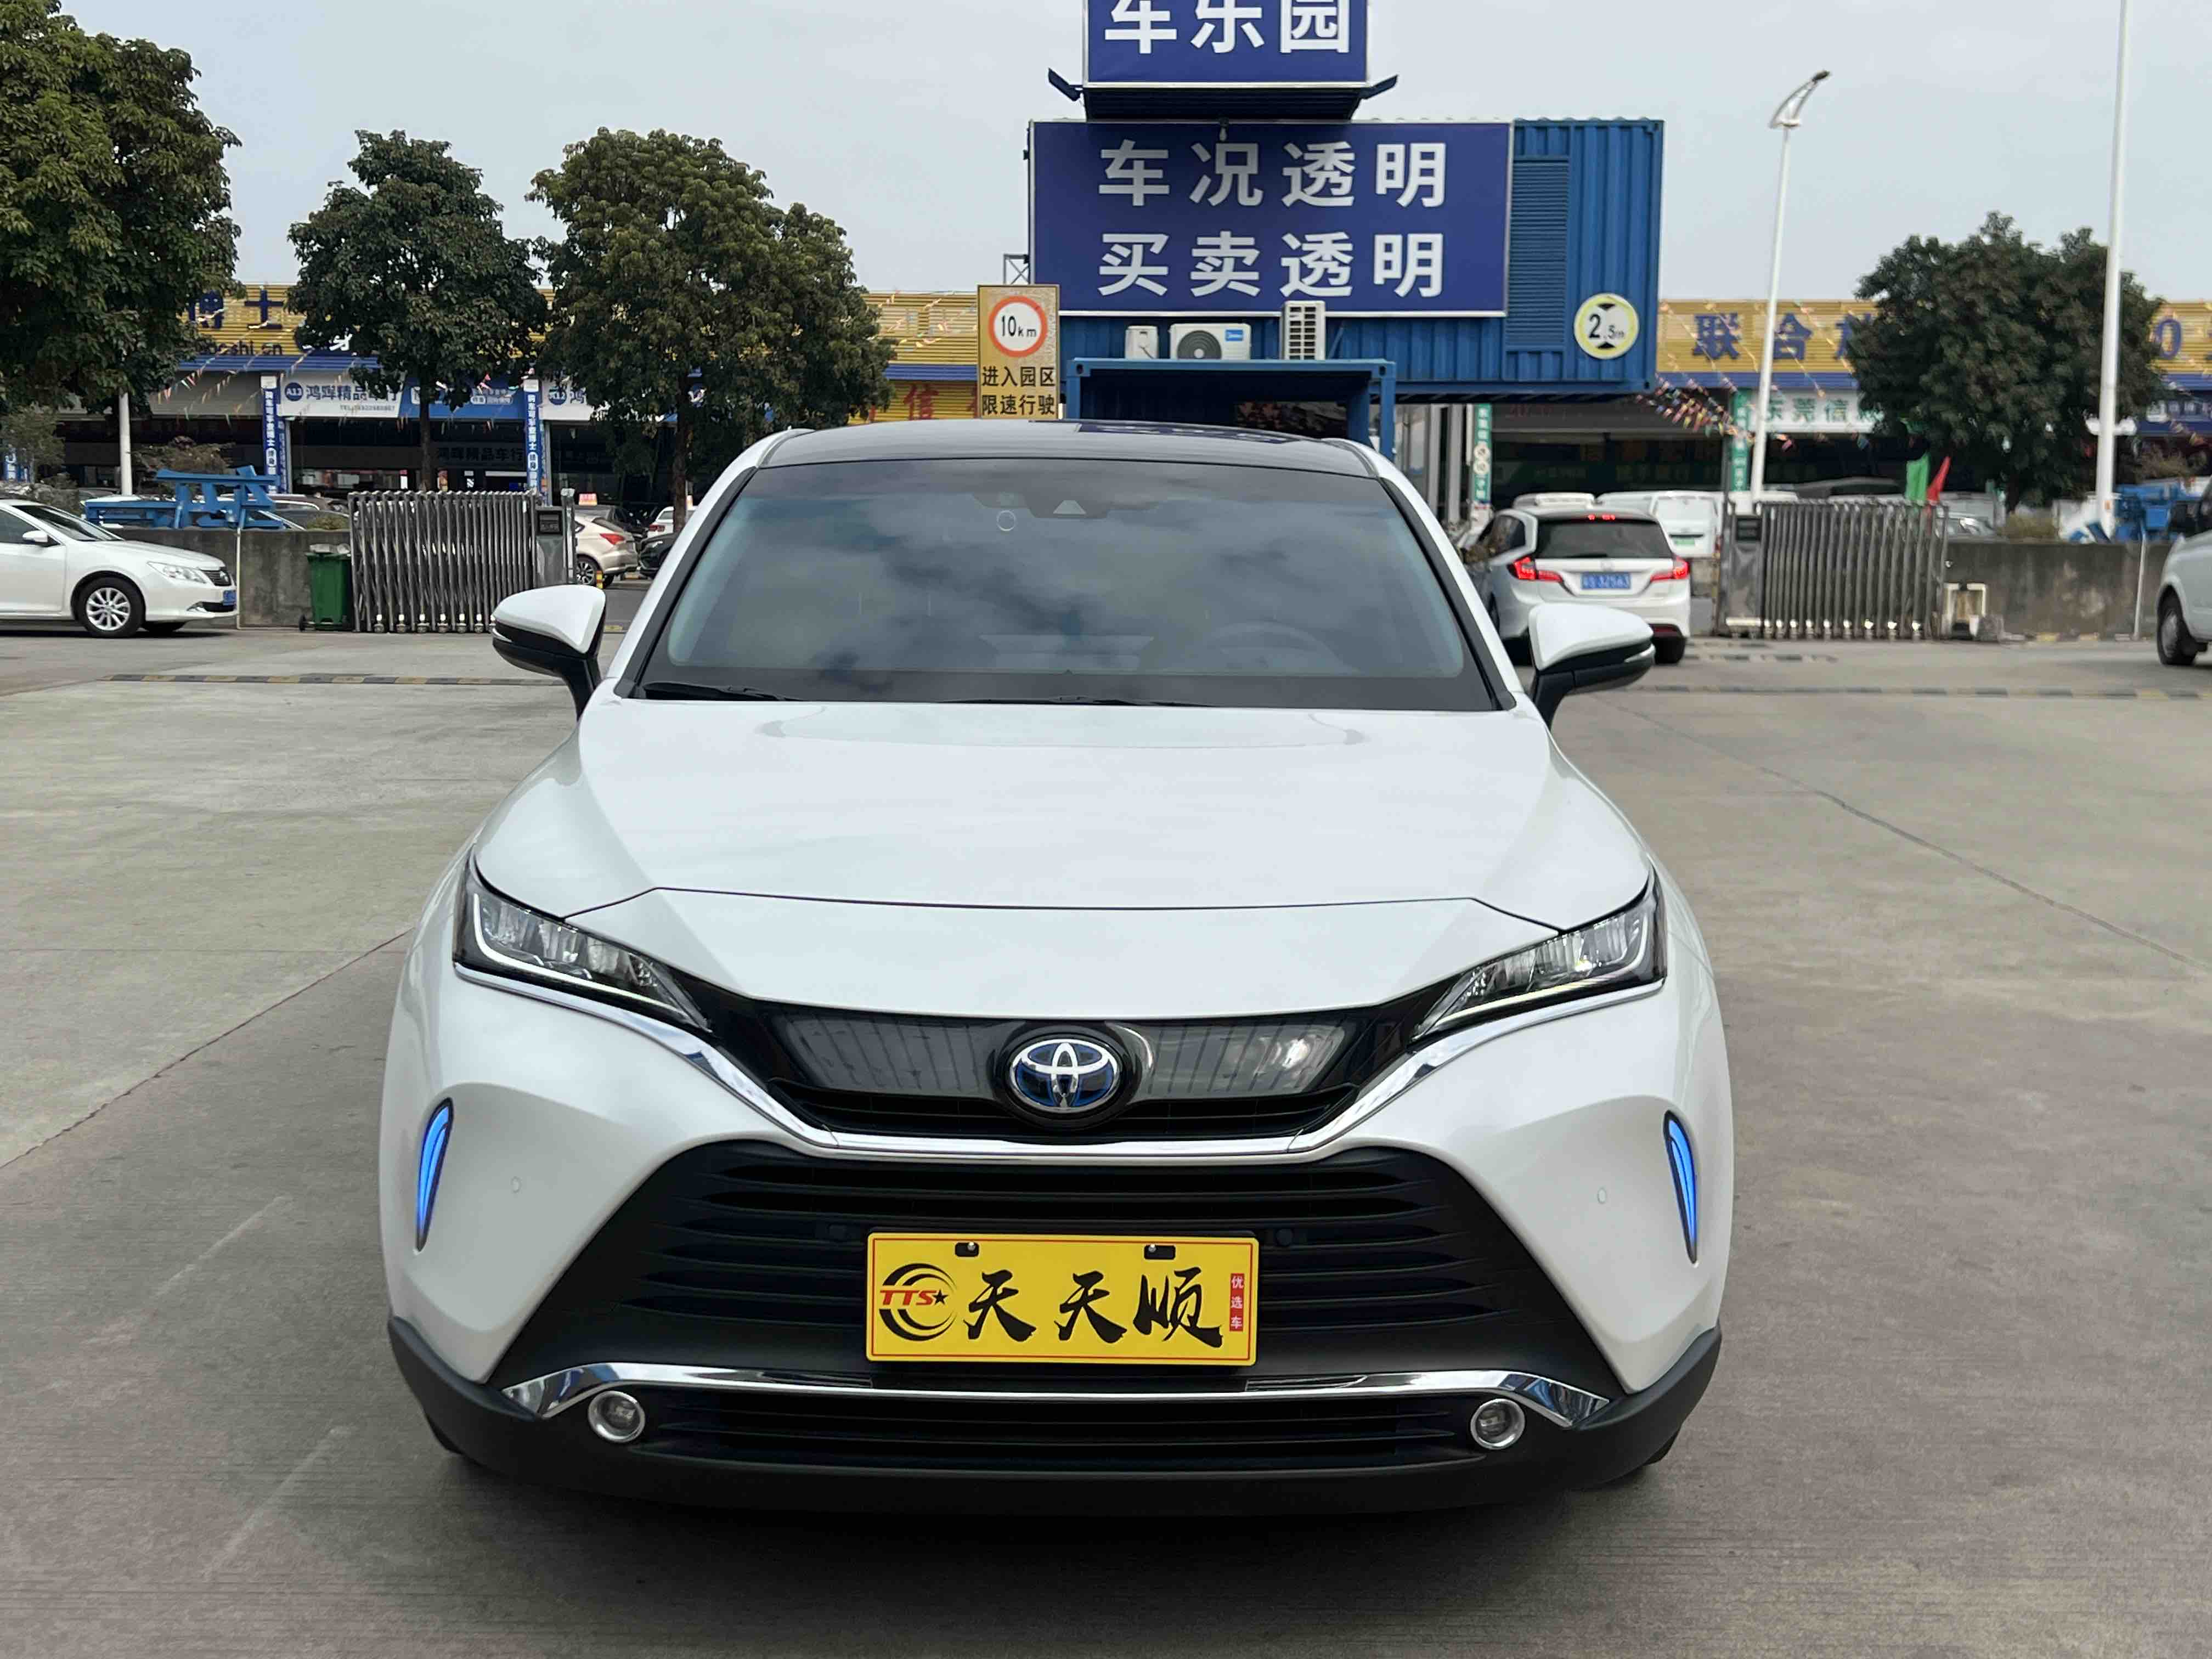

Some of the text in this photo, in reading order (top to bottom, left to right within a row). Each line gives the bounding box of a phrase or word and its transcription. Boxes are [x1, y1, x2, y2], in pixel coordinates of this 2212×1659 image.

[1099, 139, 1446, 207] 车况透明
[1098, 231, 1443, 297] 买卖透明
[1001, 315, 1037, 336] 10km
[981, 366, 1056, 387] 进入园区
[981, 394, 1056, 416] 限速行驶
[879, 1289, 936, 1305] TTS
[962, 1267, 1223, 1348] 天天顺
[1230, 1276, 1244, 1330] 优选车
